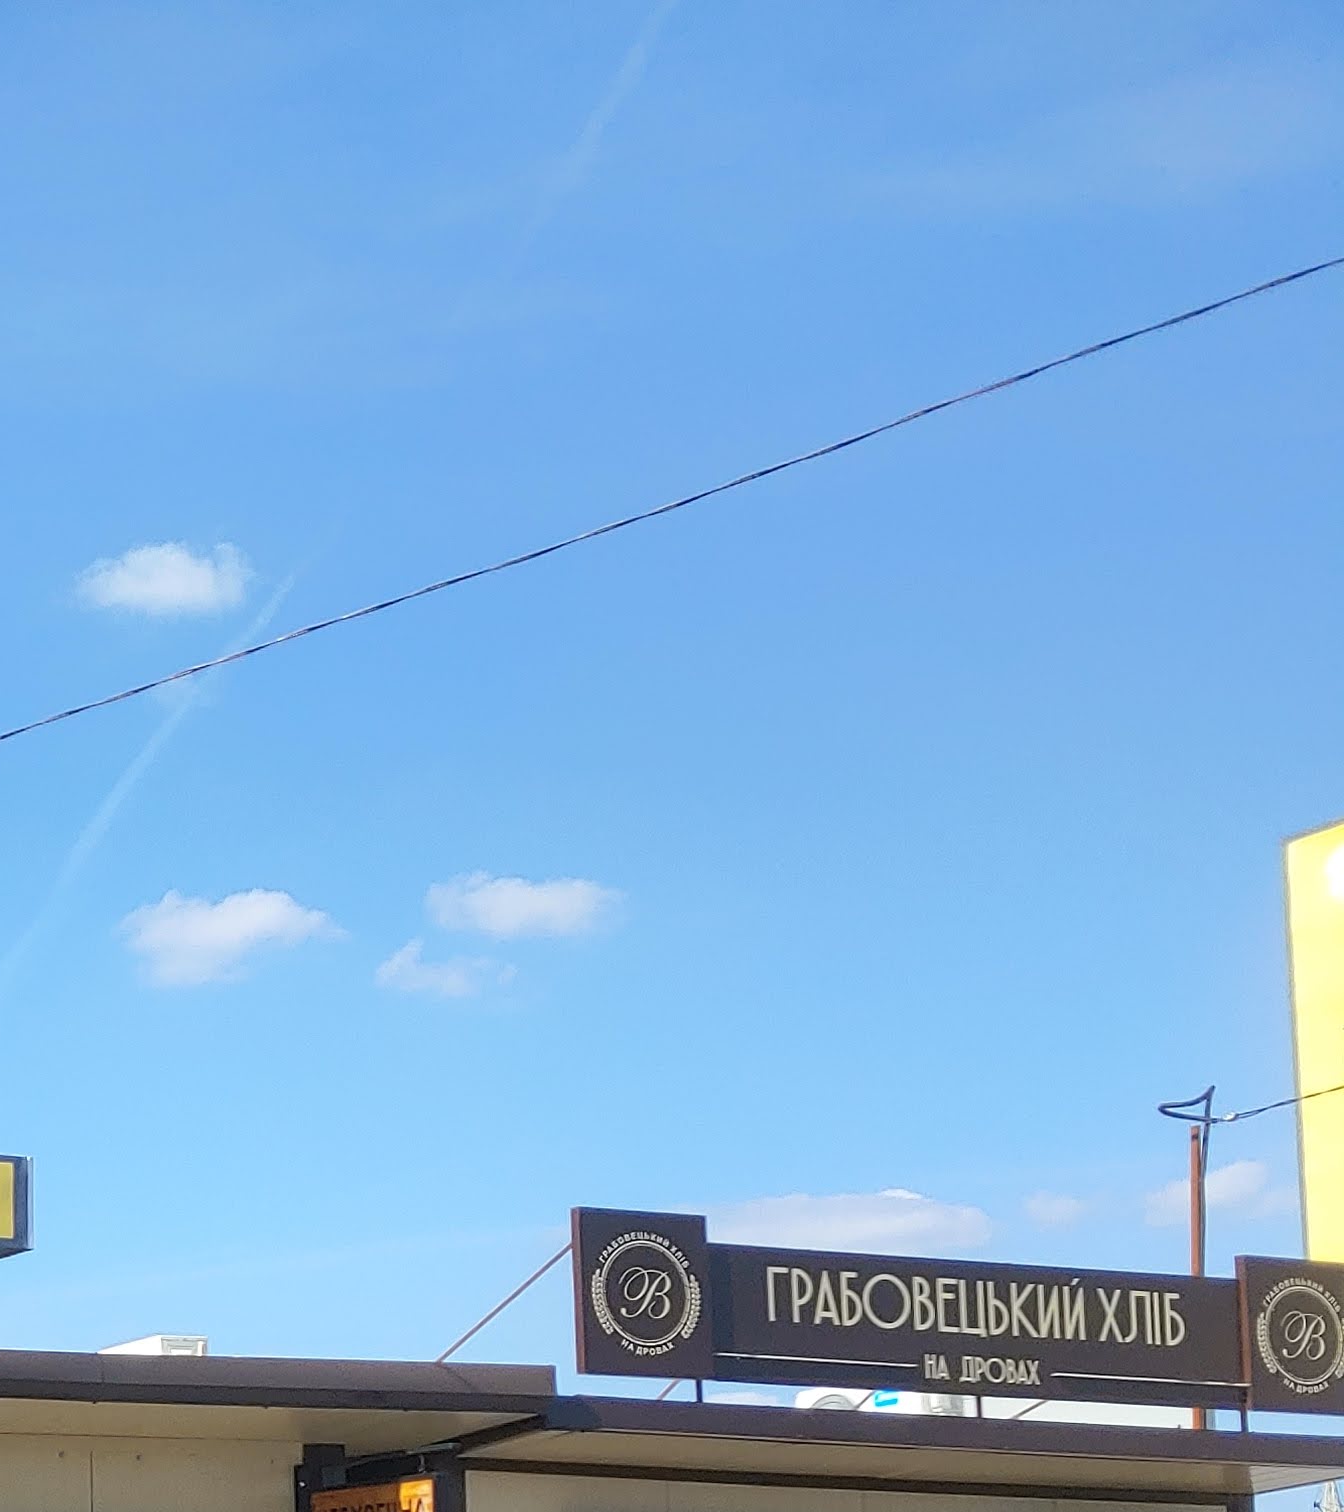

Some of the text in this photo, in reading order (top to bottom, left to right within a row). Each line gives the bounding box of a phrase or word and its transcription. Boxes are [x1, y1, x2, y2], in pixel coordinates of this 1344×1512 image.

[766, 1266, 1187, 1347] ГРАБОВЕЦЬКИЙ ХЛІБ
[923, 1353, 1041, 1385] НА ДРОВАХ
